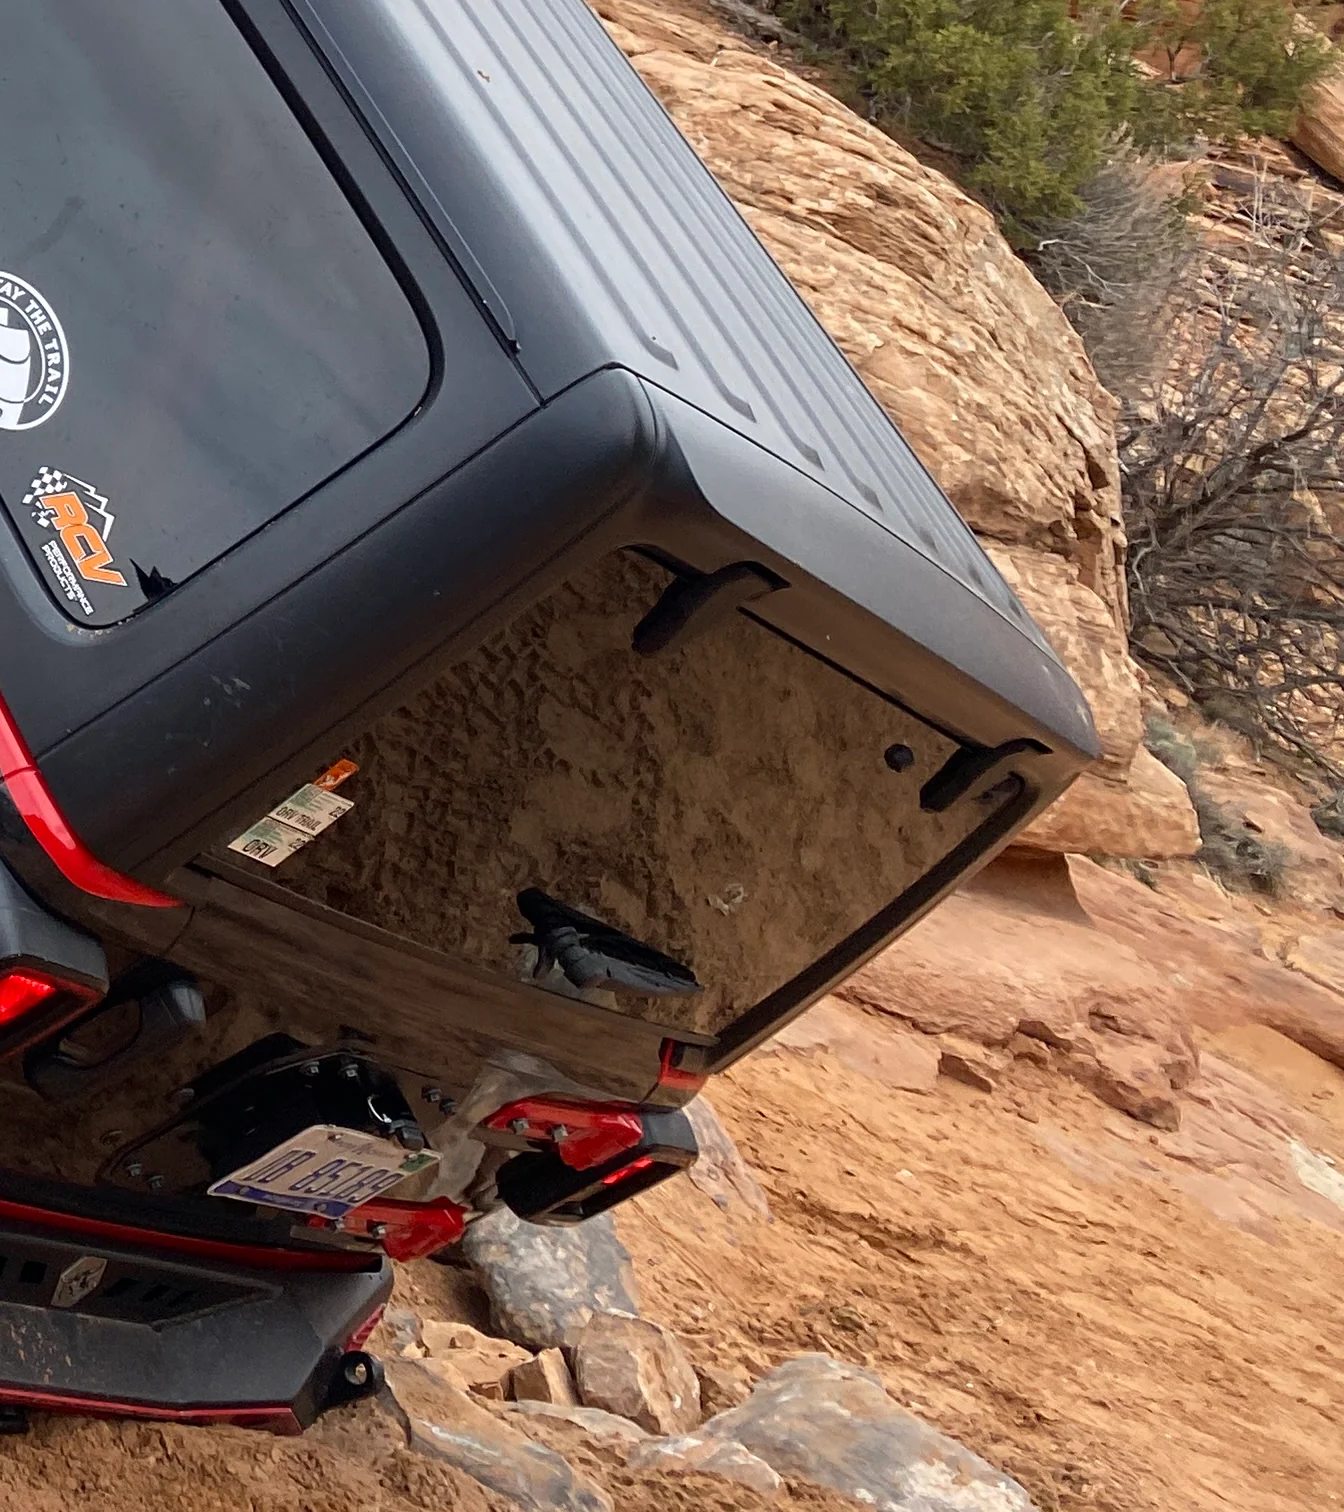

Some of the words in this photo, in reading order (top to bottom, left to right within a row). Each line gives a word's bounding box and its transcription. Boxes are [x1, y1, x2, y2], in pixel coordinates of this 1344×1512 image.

[24, 299, 52, 336] THE
[38, 337, 62, 406] TRAIL
[40, 493, 127, 587] RCV
[42, 544, 79, 601] PRODUCTS
[49, 541, 94, 616] PERFORMANCE
[243, 839, 277, 859] ORV
[288, 1159, 405, 1204] 85189
